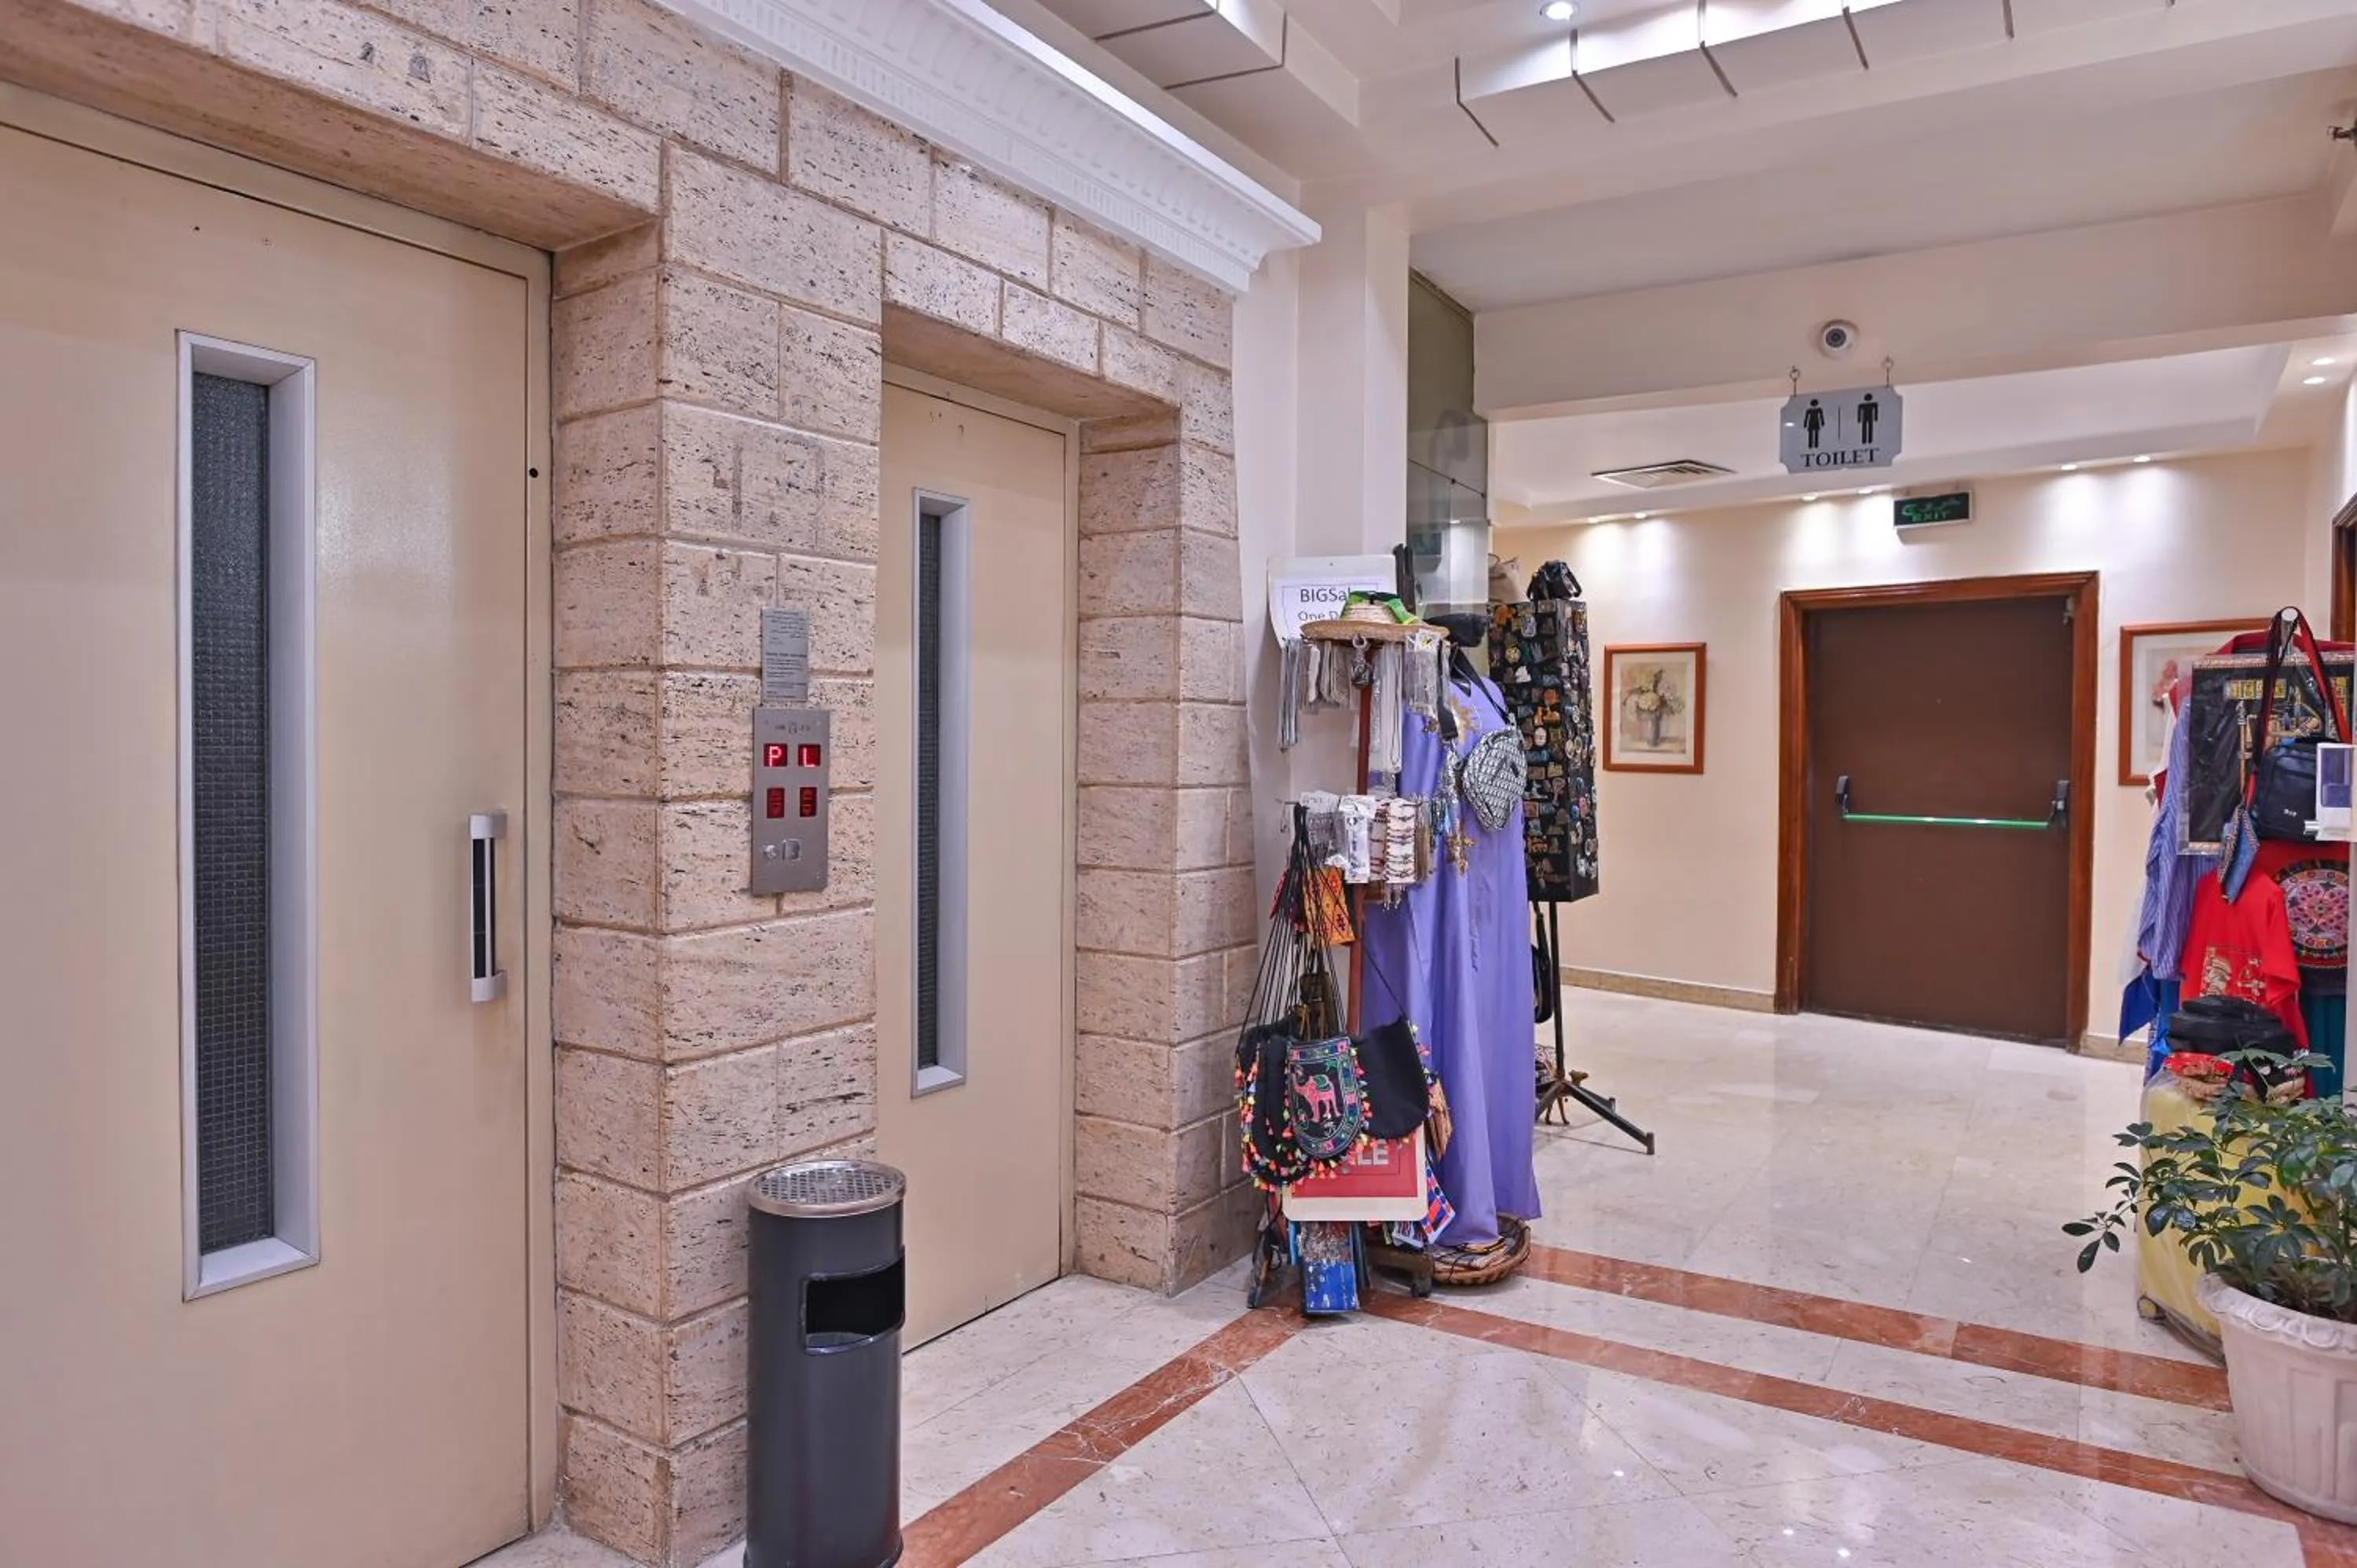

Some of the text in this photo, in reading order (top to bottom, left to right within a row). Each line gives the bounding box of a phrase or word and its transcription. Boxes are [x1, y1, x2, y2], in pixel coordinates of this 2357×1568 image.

[1800, 447, 1879, 467] TOILET
[1300, 586, 1351, 603] BIGSal
[1298, 610, 1325, 621] One
[768, 746, 783, 768] P
[802, 746, 816, 768] L
